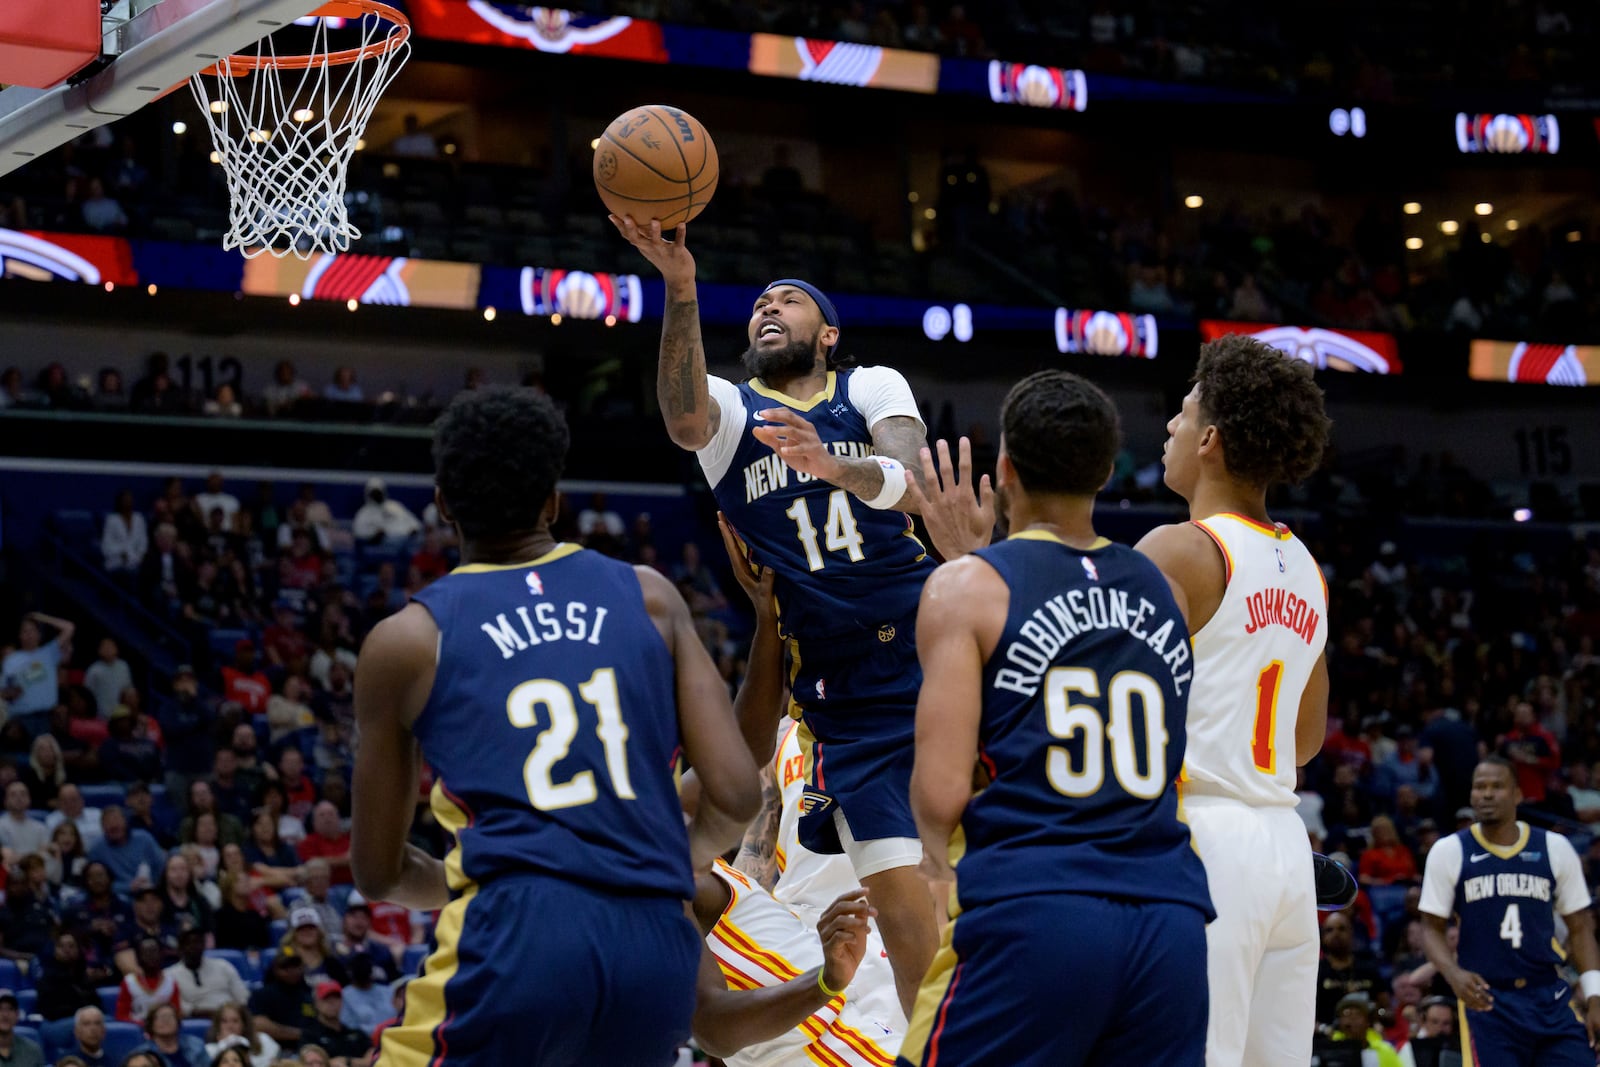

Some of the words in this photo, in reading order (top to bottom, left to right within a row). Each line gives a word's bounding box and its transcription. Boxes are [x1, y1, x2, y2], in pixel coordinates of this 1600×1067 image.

[743, 452, 788, 504] NEW
[785, 489, 866, 572] 14
[481, 602, 608, 659] MISSI
[994, 586, 1192, 697] ROBINSON-EARL
[1245, 588, 1320, 646] JOHNSON
[506, 667, 637, 811] 21
[1044, 666, 1169, 799] 50
[1251, 659, 1284, 775] 1
[1464, 874, 1495, 904] NEW
[1496, 873, 1551, 902] ORLEANS
[1500, 903, 1523, 948] 4
